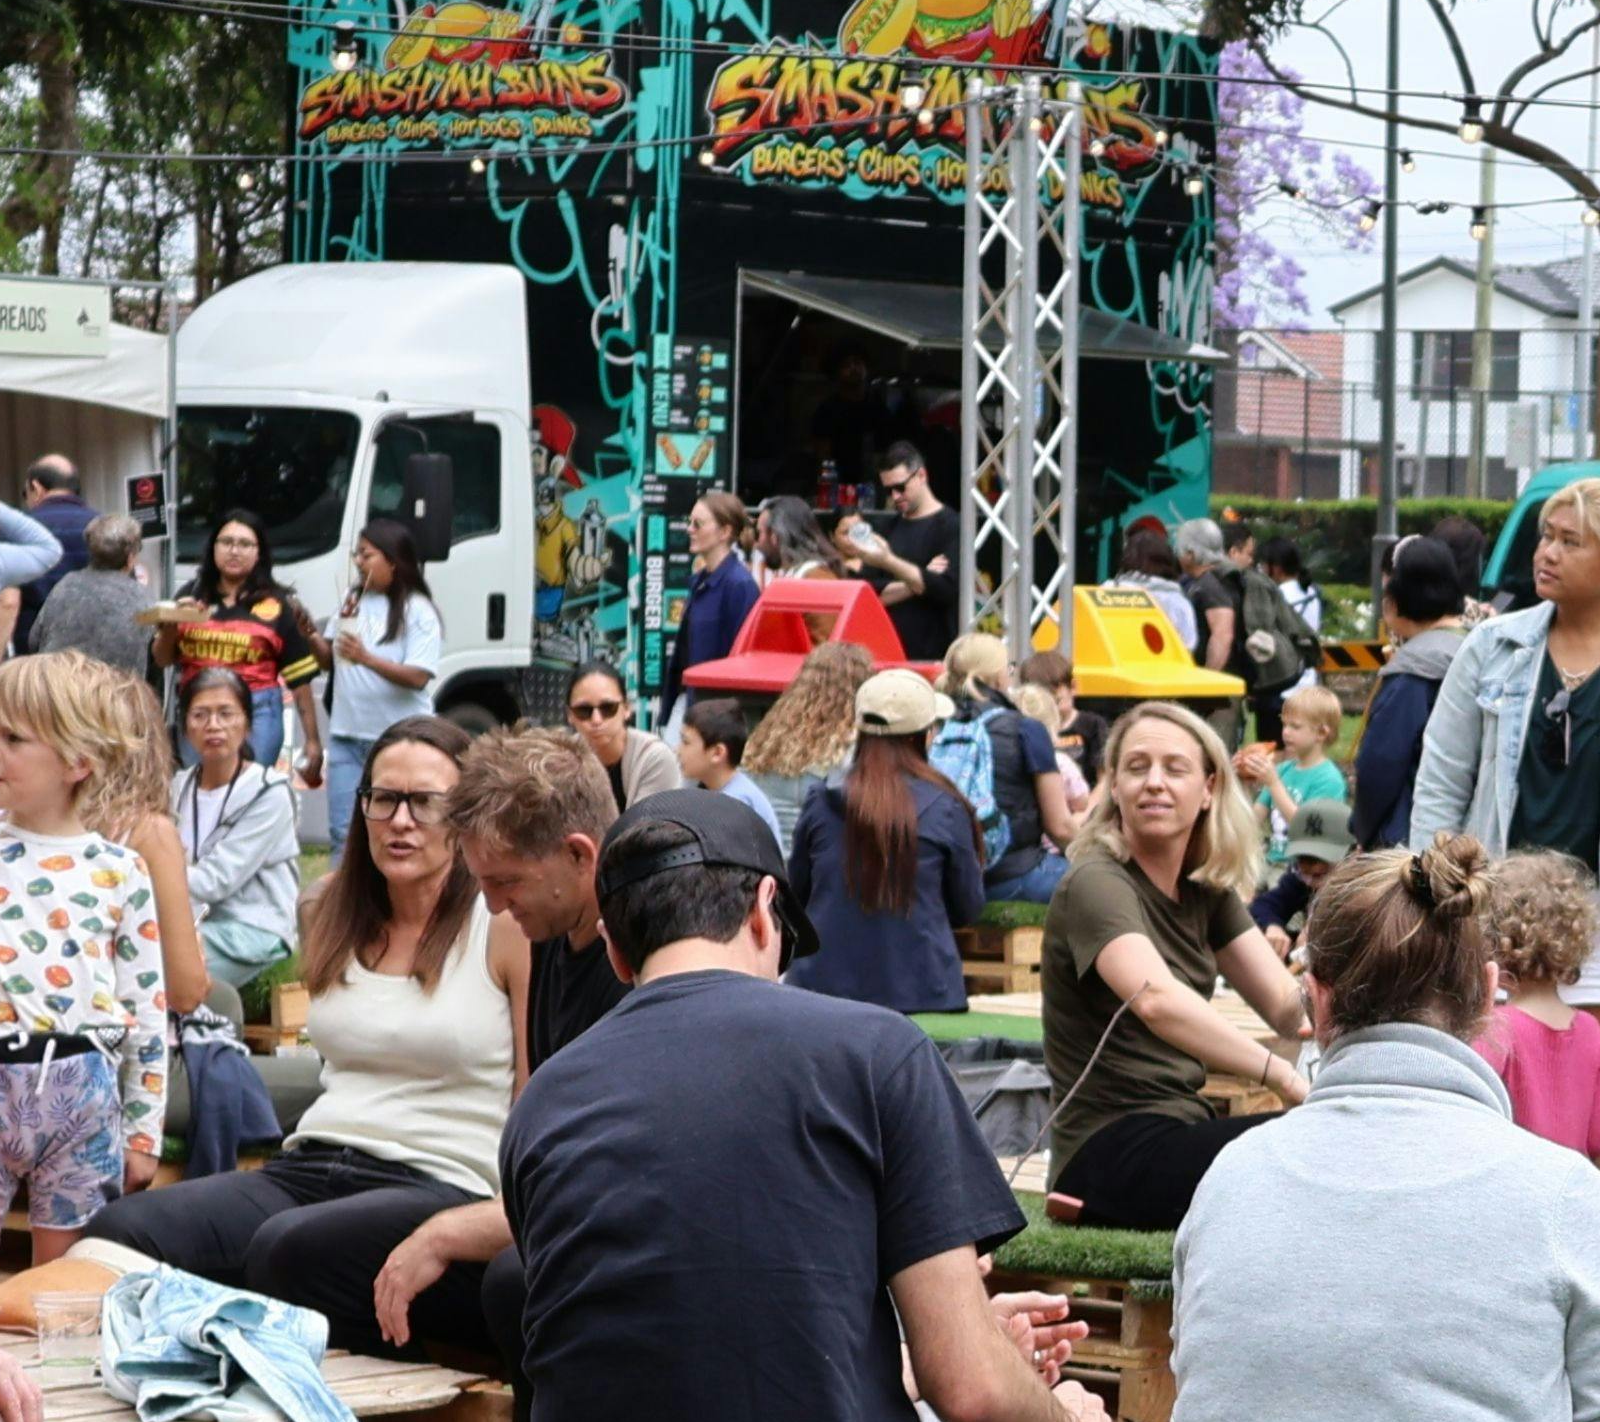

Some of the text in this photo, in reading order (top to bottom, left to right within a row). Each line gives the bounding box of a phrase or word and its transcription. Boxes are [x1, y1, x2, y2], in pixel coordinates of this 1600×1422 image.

[300, 56, 622, 137] SMASH MY BUNS
[326, 115, 592, 143] BURGERS CHIPS HOT DOGS DRINKS
[710, 56, 904, 163] SMASH
[752, 142, 848, 177] BURGERS
[858, 144, 920, 186] CHIPS
[644, 555, 665, 630] BURGER
[644, 631, 662, 686] MENU
